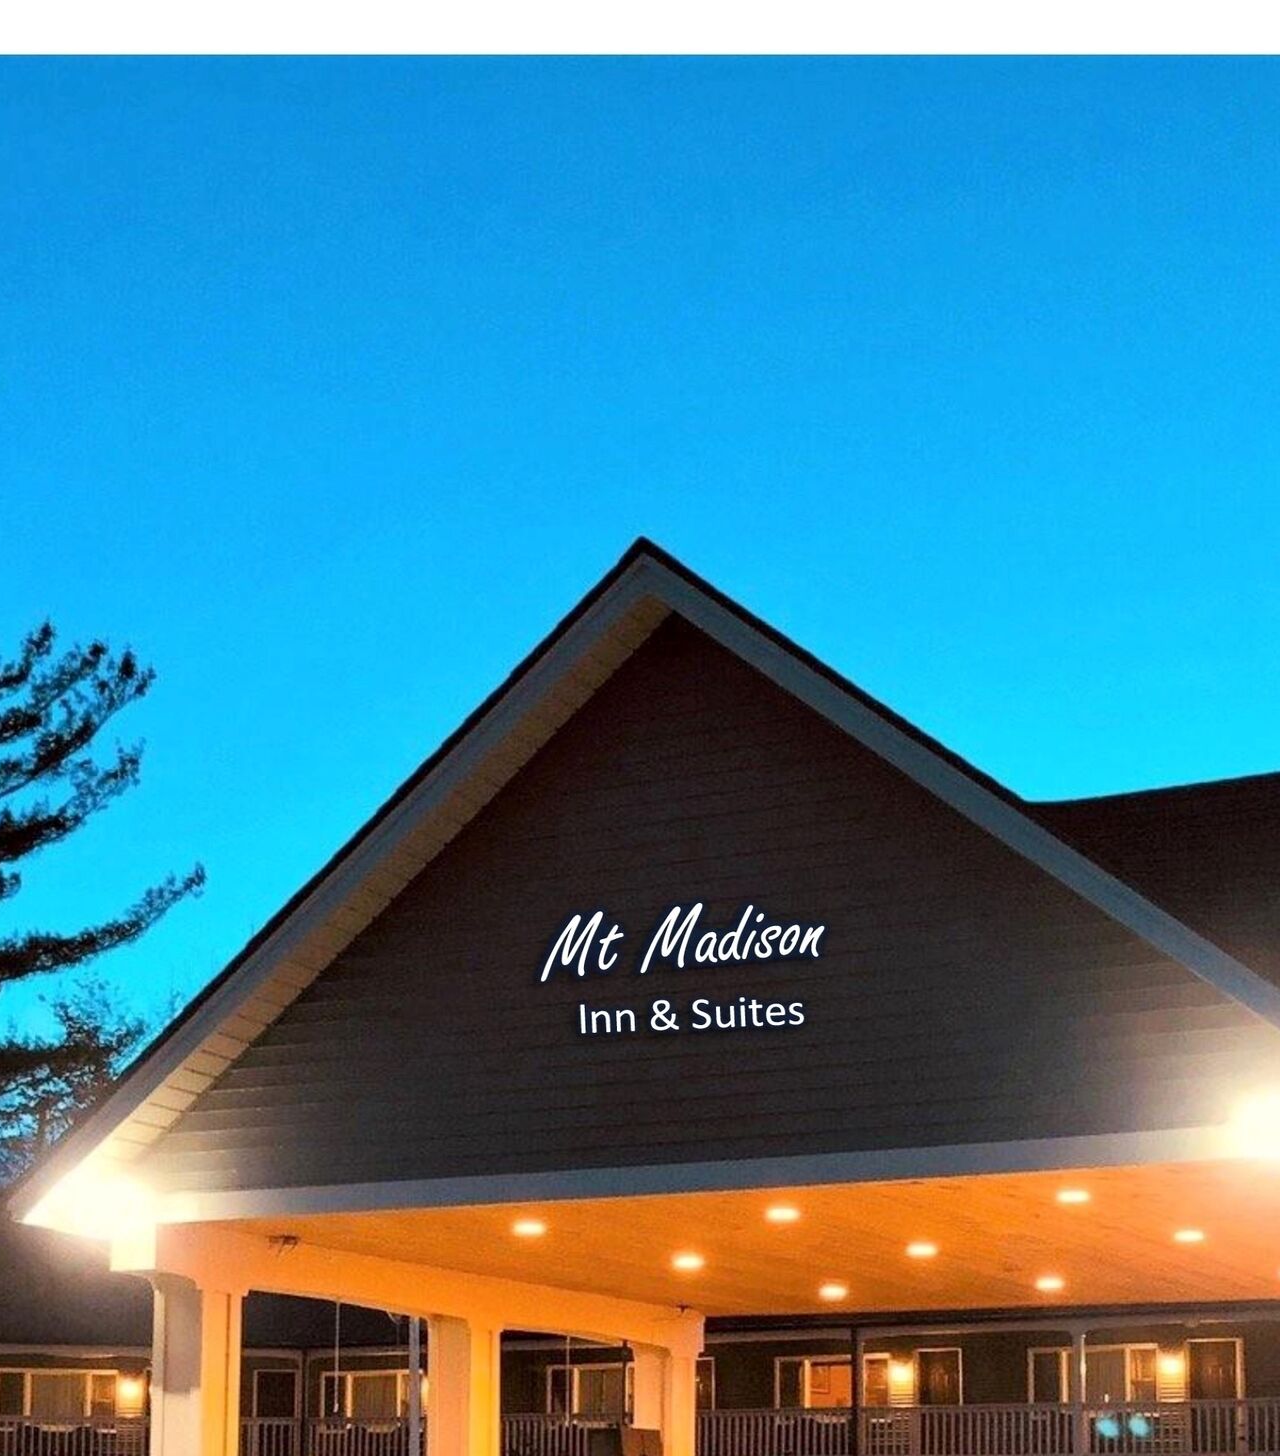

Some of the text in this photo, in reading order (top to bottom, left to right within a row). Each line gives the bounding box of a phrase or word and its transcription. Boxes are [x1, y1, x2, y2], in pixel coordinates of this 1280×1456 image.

[540, 902, 825, 983] Mt Madison
[579, 996, 805, 1034] Inn & Suites
